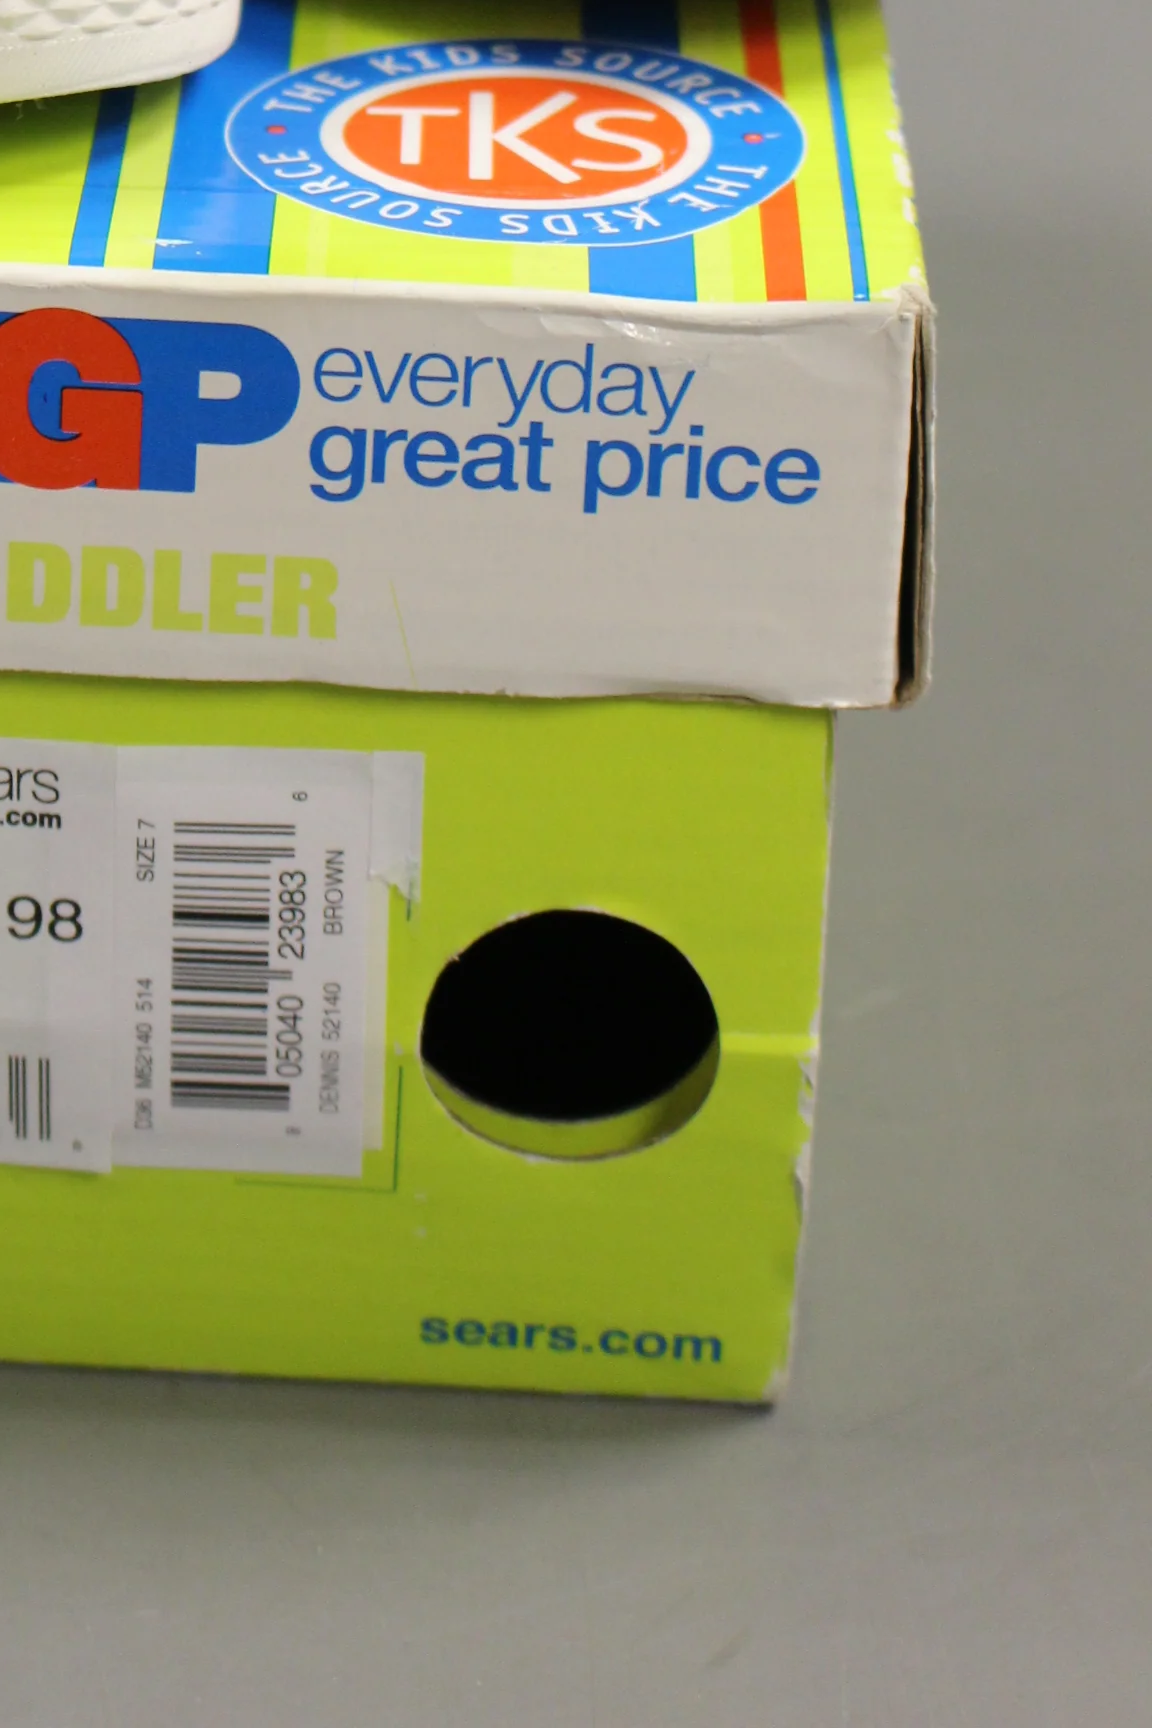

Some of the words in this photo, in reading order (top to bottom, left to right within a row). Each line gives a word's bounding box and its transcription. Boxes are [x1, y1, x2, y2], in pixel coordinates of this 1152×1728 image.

[263, 70, 362, 116] THE
[368, 43, 522, 76] KIDS
[554, 44, 763, 119] SOURCE
[366, 90, 666, 184] TKS
[258, 147, 464, 230] SOURCE
[499, 200, 662, 236] KIDS
[667, 162, 769, 213] THE
[312, 342, 696, 437] everyday
[308, 420, 553, 503] great
[582, 424, 822, 514] price
[137, 818, 155, 830] 7
[292, 790, 308, 802] 6
[136, 836, 155, 883] SIZE
[323, 849, 345, 936] BROWN
[277, 869, 307, 960] 23983
[134, 977, 153, 1012] 514
[321, 981, 341, 1041] 52140
[276, 994, 304, 1078] 05040
[318, 1048, 340, 1115] DENNIS
[420, 1316, 724, 1364] sears.com
